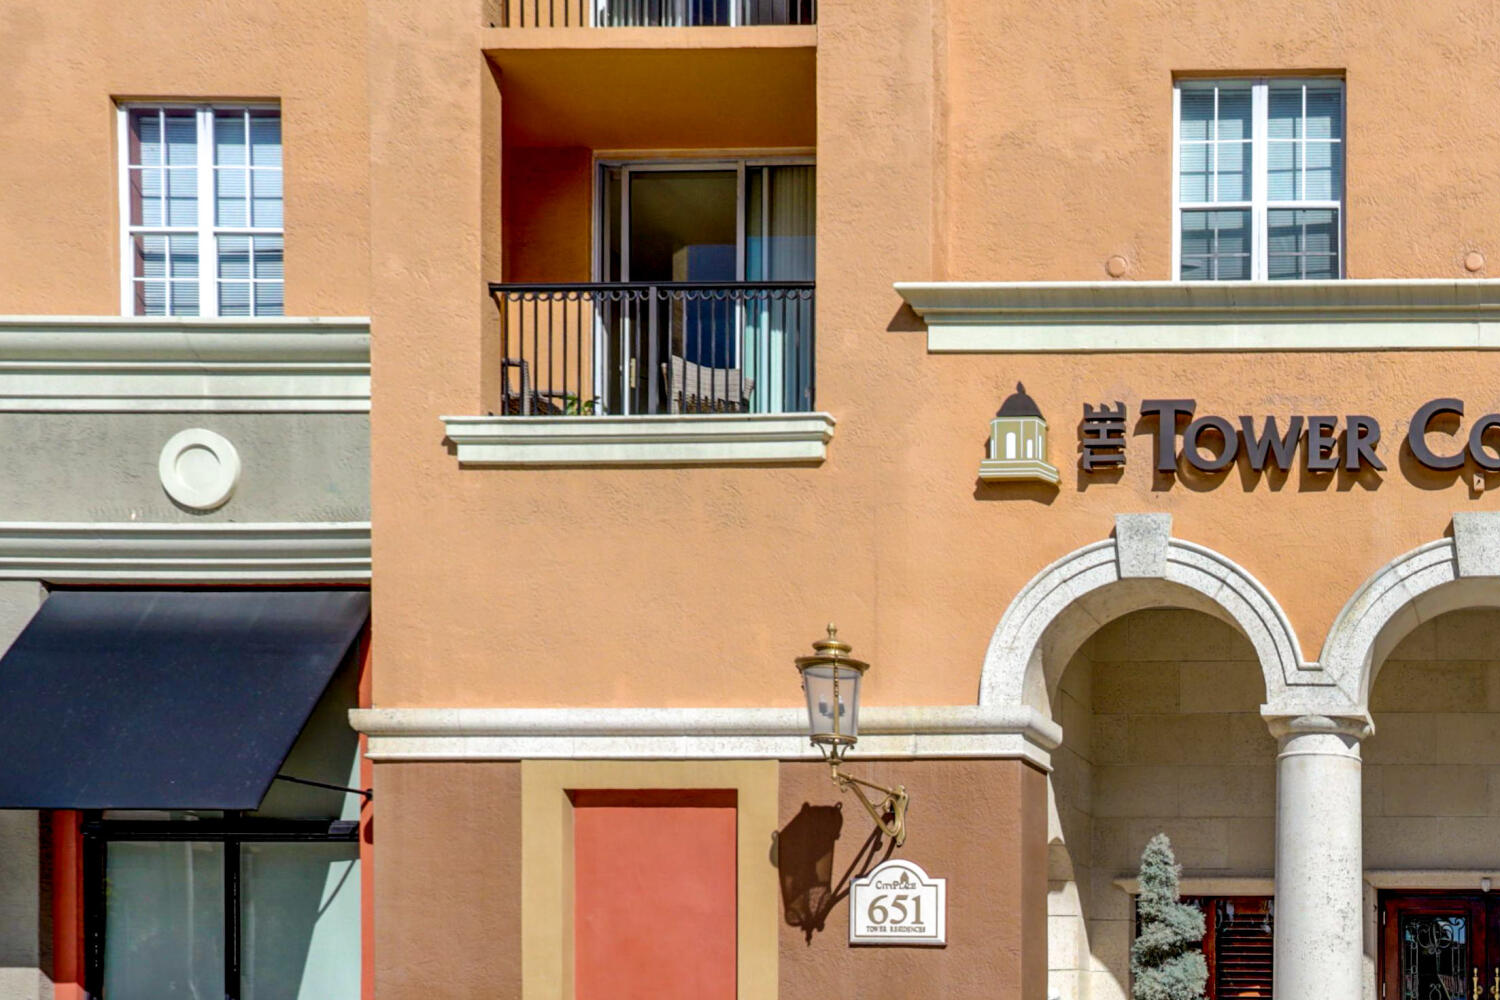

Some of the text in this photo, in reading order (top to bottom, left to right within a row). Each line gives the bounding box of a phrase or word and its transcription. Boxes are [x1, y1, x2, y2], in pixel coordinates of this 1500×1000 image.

[1083, 400, 1127, 472] THE
[1140, 398, 1387, 472] TOWER
[867, 894, 924, 925] 651
[866, 925, 887, 933] TOWER
